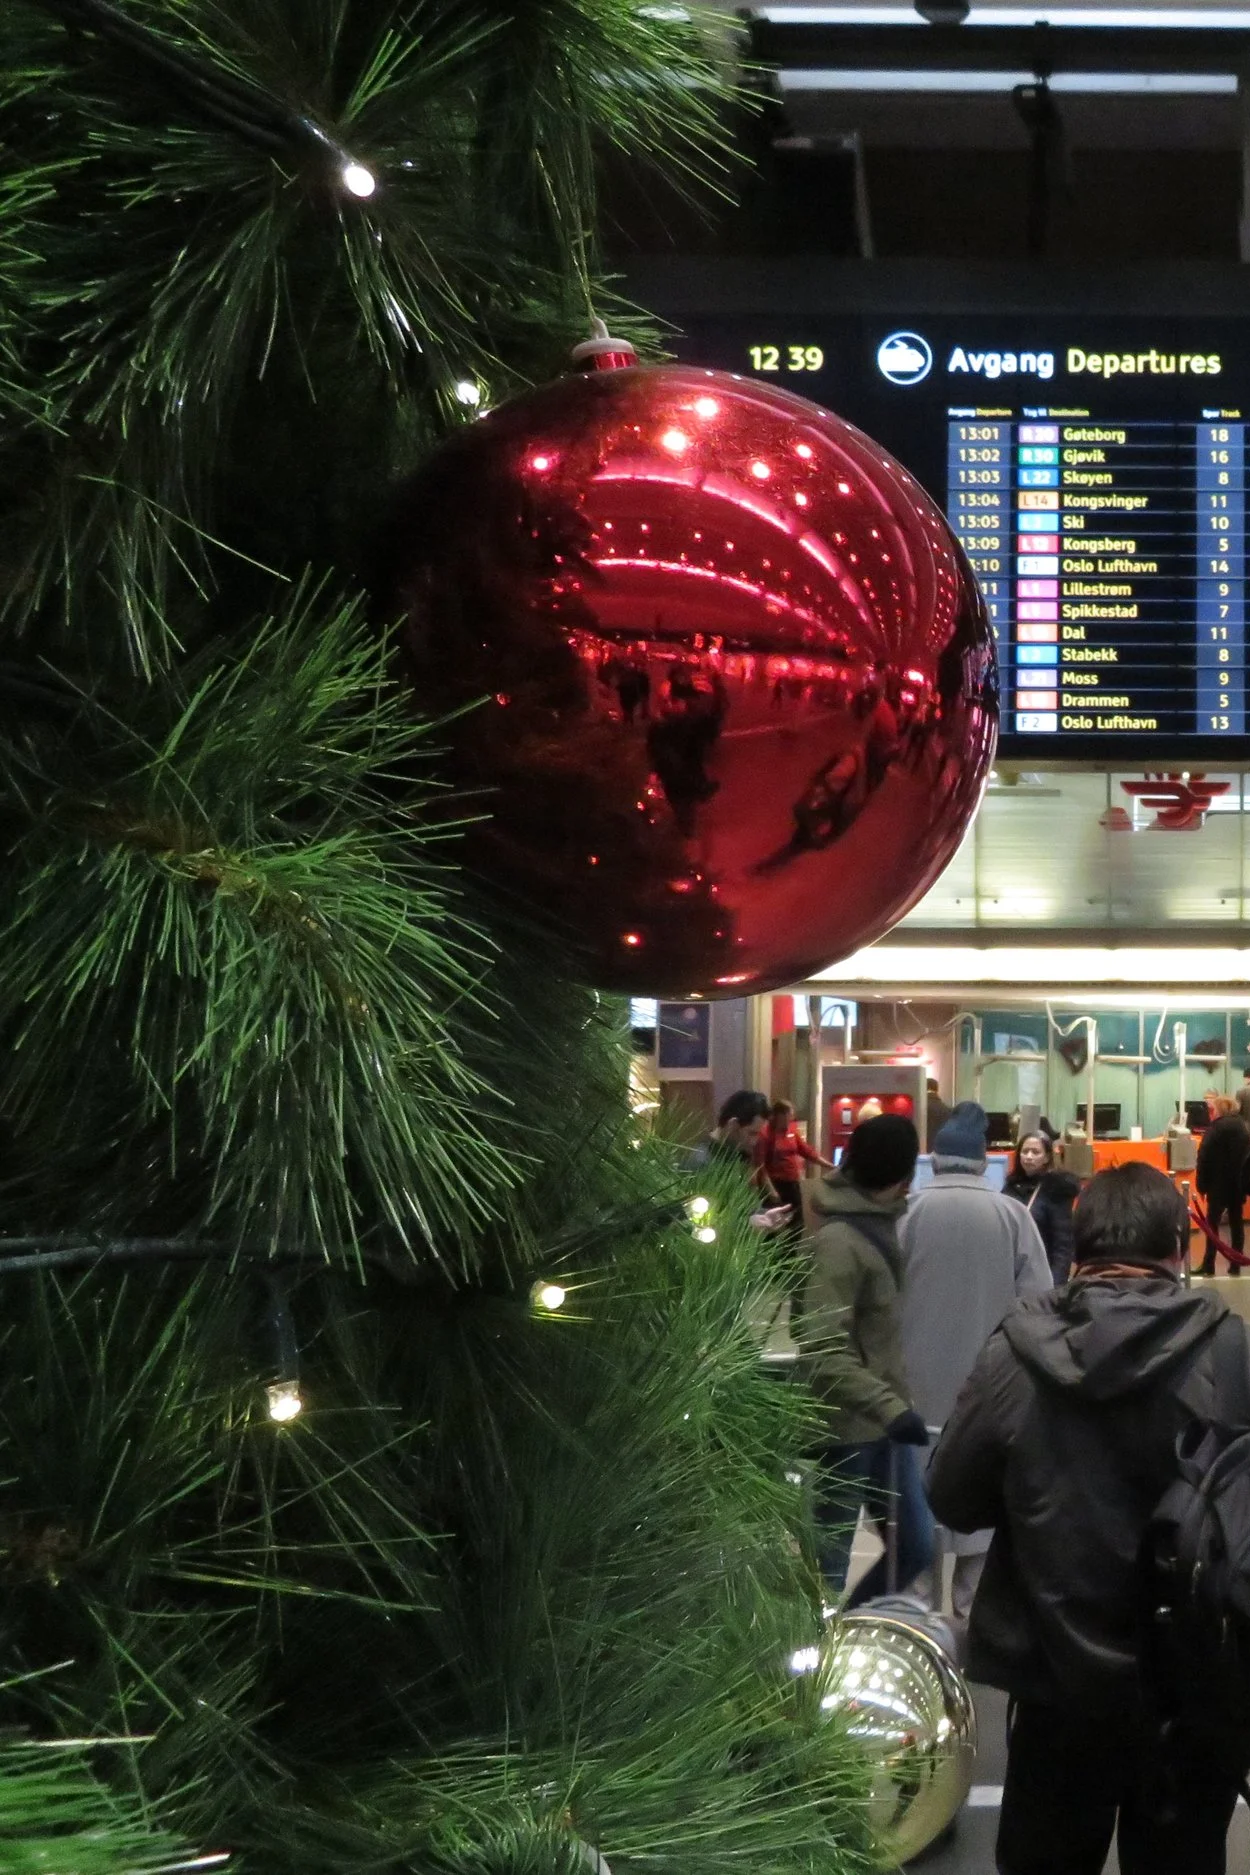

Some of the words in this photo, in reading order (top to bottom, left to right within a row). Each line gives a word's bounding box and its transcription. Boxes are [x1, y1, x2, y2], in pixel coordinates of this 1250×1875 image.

[750, 346, 779, 370] 12
[788, 347, 823, 371] 39
[948, 348, 1054, 378] Avgang
[1068, 349, 1221, 378] Departures
[960, 427, 998, 440] 13:01
[1064, 428, 1125, 444] Gøteborg
[1211, 429, 1228, 442] 18
[960, 449, 1000, 462] 13:02
[1063, 449, 1105, 465] Gjøvik
[1211, 451, 1228, 463] 16
[960, 470, 1000, 483] 13:03
[1063, 471, 1112, 486] Skøyen
[1219, 472, 1228, 484] 8
[959, 494, 1000, 506] 13:04
[1064, 494, 1148, 510] Kongsvinger
[1211, 495, 1226, 507] 11
[959, 515, 999, 528] 13:05
[1063, 515, 1084, 528] Ski
[1211, 517, 1229, 529] 10
[1063, 538, 1135, 553] Kongsberg
[1220, 538, 1228, 551] 5
[1063, 559, 1094, 572] Oslo
[1098, 559, 1157, 572] Lufthavn
[1211, 561, 1229, 572] 14
[1063, 582, 1131, 595] Lillestrøm
[1219, 584, 1228, 596] 9
[1062, 604, 1137, 619] Spikkestad
[1220, 605, 1228, 617] 7
[1063, 626, 1085, 639] Dal
[1211, 627, 1226, 639] 11
[1062, 648, 1117, 661] Stabekk
[1219, 649, 1229, 661] 8
[1062, 672, 1098, 685] Moss
[1219, 673, 1228, 685] 9
[1063, 694, 1129, 707] Drammen
[1220, 695, 1228, 707] 5
[1062, 716, 1093, 728] Oslo
[1097, 716, 1156, 729] Lufthavn
[1211, 716, 1229, 729] 13
